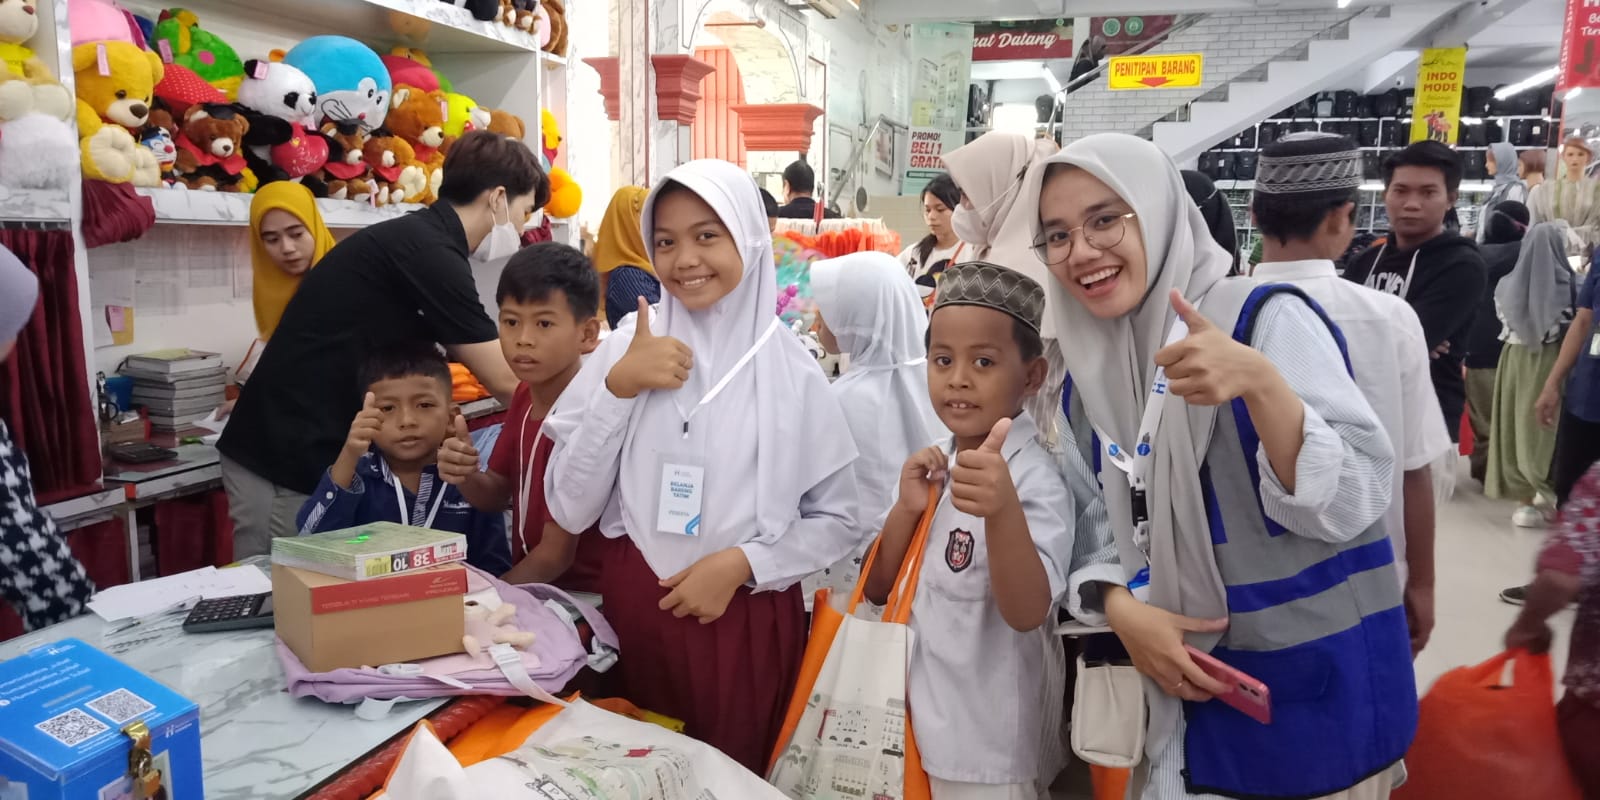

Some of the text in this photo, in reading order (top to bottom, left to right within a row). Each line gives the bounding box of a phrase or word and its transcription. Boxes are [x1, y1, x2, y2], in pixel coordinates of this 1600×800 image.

[998, 32, 1057, 49] Datang
[1115, 59, 1196, 77] PENITIPAN BARANG
[1426, 71, 1457, 81] INDO
[1423, 82, 1458, 92] MODE
[911, 131, 942, 141] PROMO!
[911, 141, 943, 155] BELI 1
[392, 556, 409, 572] 10
[412, 551, 431, 567] 38
